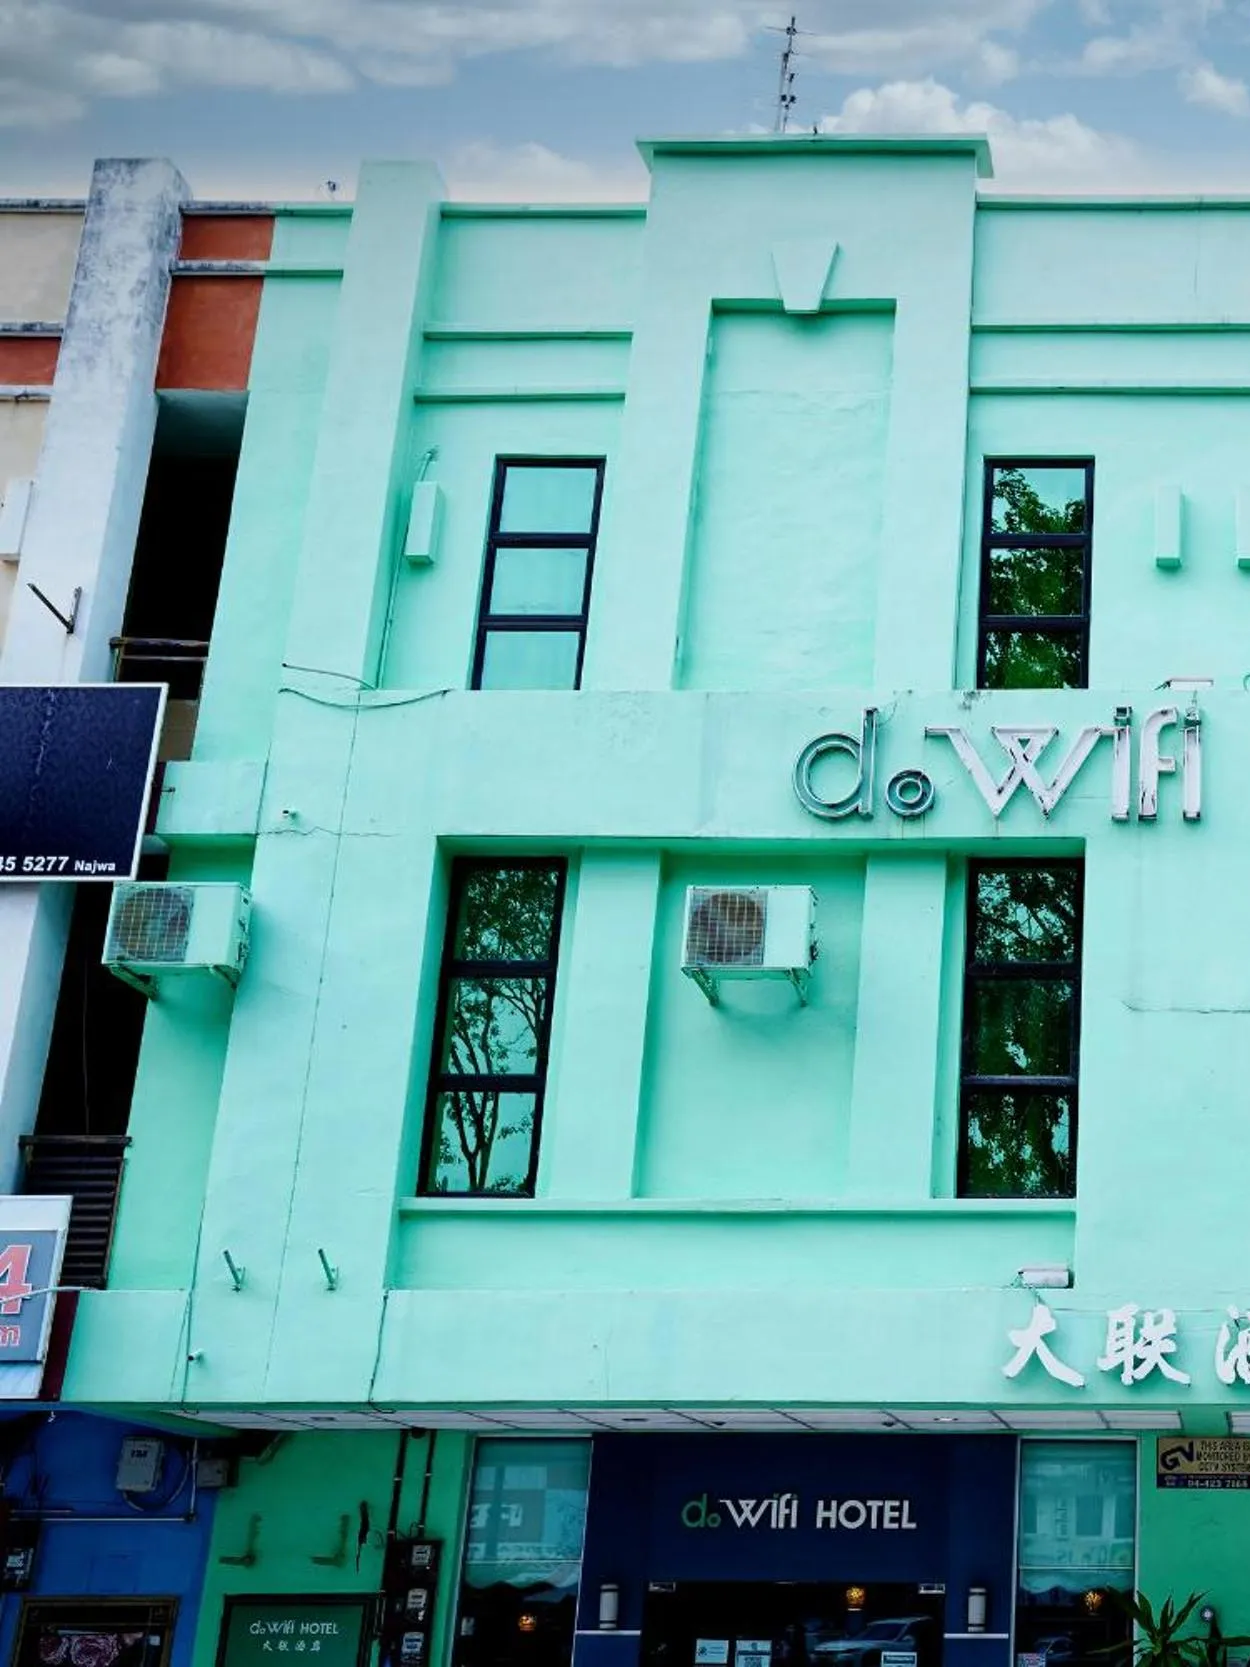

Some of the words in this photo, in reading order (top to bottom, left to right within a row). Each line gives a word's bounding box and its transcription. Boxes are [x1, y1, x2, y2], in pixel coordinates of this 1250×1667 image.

[22, 856, 70, 871] 5277
[74, 860, 116, 874] Najwa
[1200, 1440, 1217, 1450] THIS
[1219, 1440, 1241, 1450] AREA
[1242, 1441, 1250, 1451] IS
[1196, 1451, 1241, 1461] MONITORED
[816, 1499, 917, 1530] HOTEL
[300, 1620, 339, 1635] HOTEL
